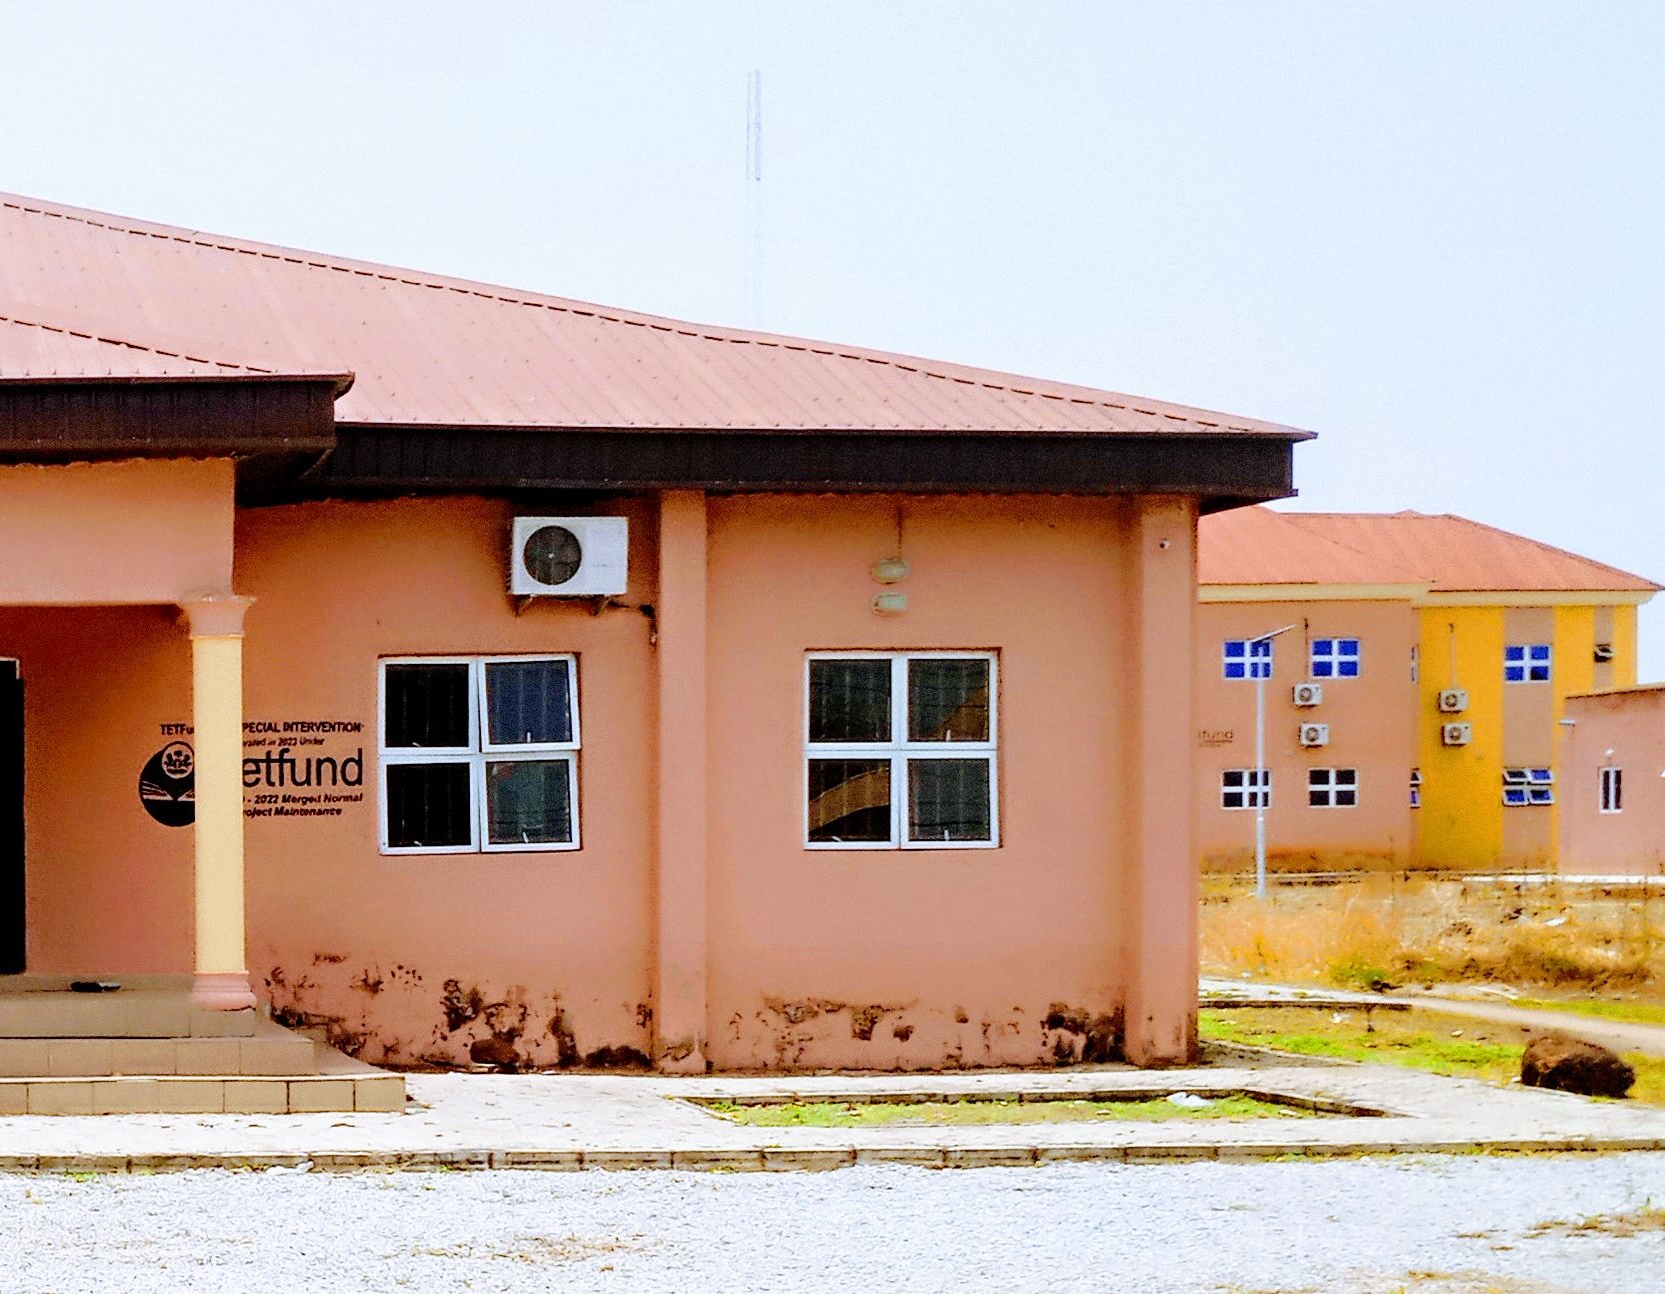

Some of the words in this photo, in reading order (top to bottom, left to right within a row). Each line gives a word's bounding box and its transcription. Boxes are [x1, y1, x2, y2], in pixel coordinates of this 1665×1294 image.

[160, 723, 194, 736] TETFu
[242, 721, 281, 733] PECIAL
[282, 721, 362, 733] INTERVENTION
[299, 737, 325, 746] Under
[242, 748, 363, 787] etfund
[254, 794, 280, 805] 2022
[281, 794, 322, 806] Merged
[323, 792, 363, 803] Normal
[242, 807, 273, 818] roject
[274, 806, 342, 816] Maintenance
